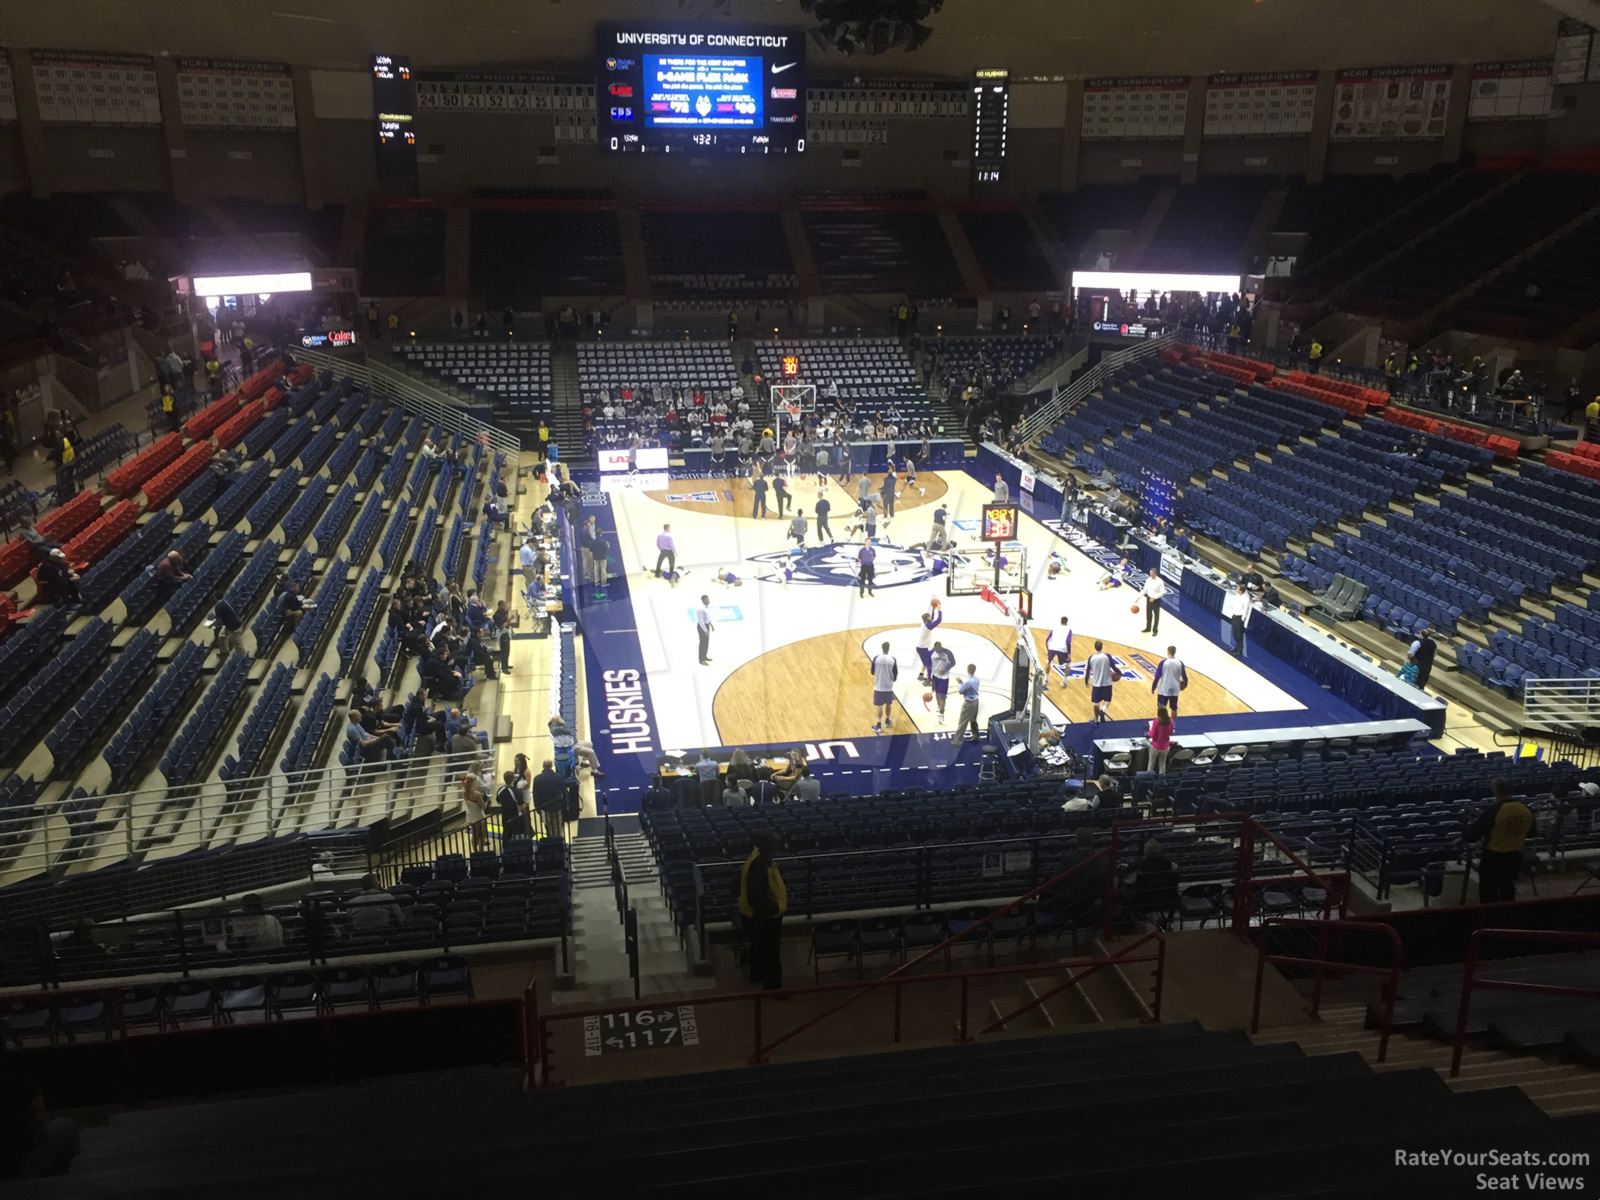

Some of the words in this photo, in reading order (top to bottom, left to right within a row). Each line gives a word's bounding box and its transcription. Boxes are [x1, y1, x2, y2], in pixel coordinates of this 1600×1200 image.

[616, 32, 686, 45] UNIVERSITY
[689, 34, 705, 46] OF
[707, 34, 788, 48] CONNECTICUT
[1373, 66, 1447, 76] CHAMPIONSHIP
[420, 94, 435, 106] 24
[443, 95, 458, 106] 50
[468, 95, 480, 107] 21
[489, 96, 503, 107] 52
[611, 137, 618, 150] 0
[693, 134, 717, 145] 43:21
[797, 139, 805, 152] 0
[978, 171, 1000, 181] 11:14
[328, 330, 351, 342] Coke
[785, 363, 797, 374] 30
[602, 668, 653, 755] HUSKIES
[603, 1010, 656, 1029] 116
[625, 1027, 679, 1048] 117
